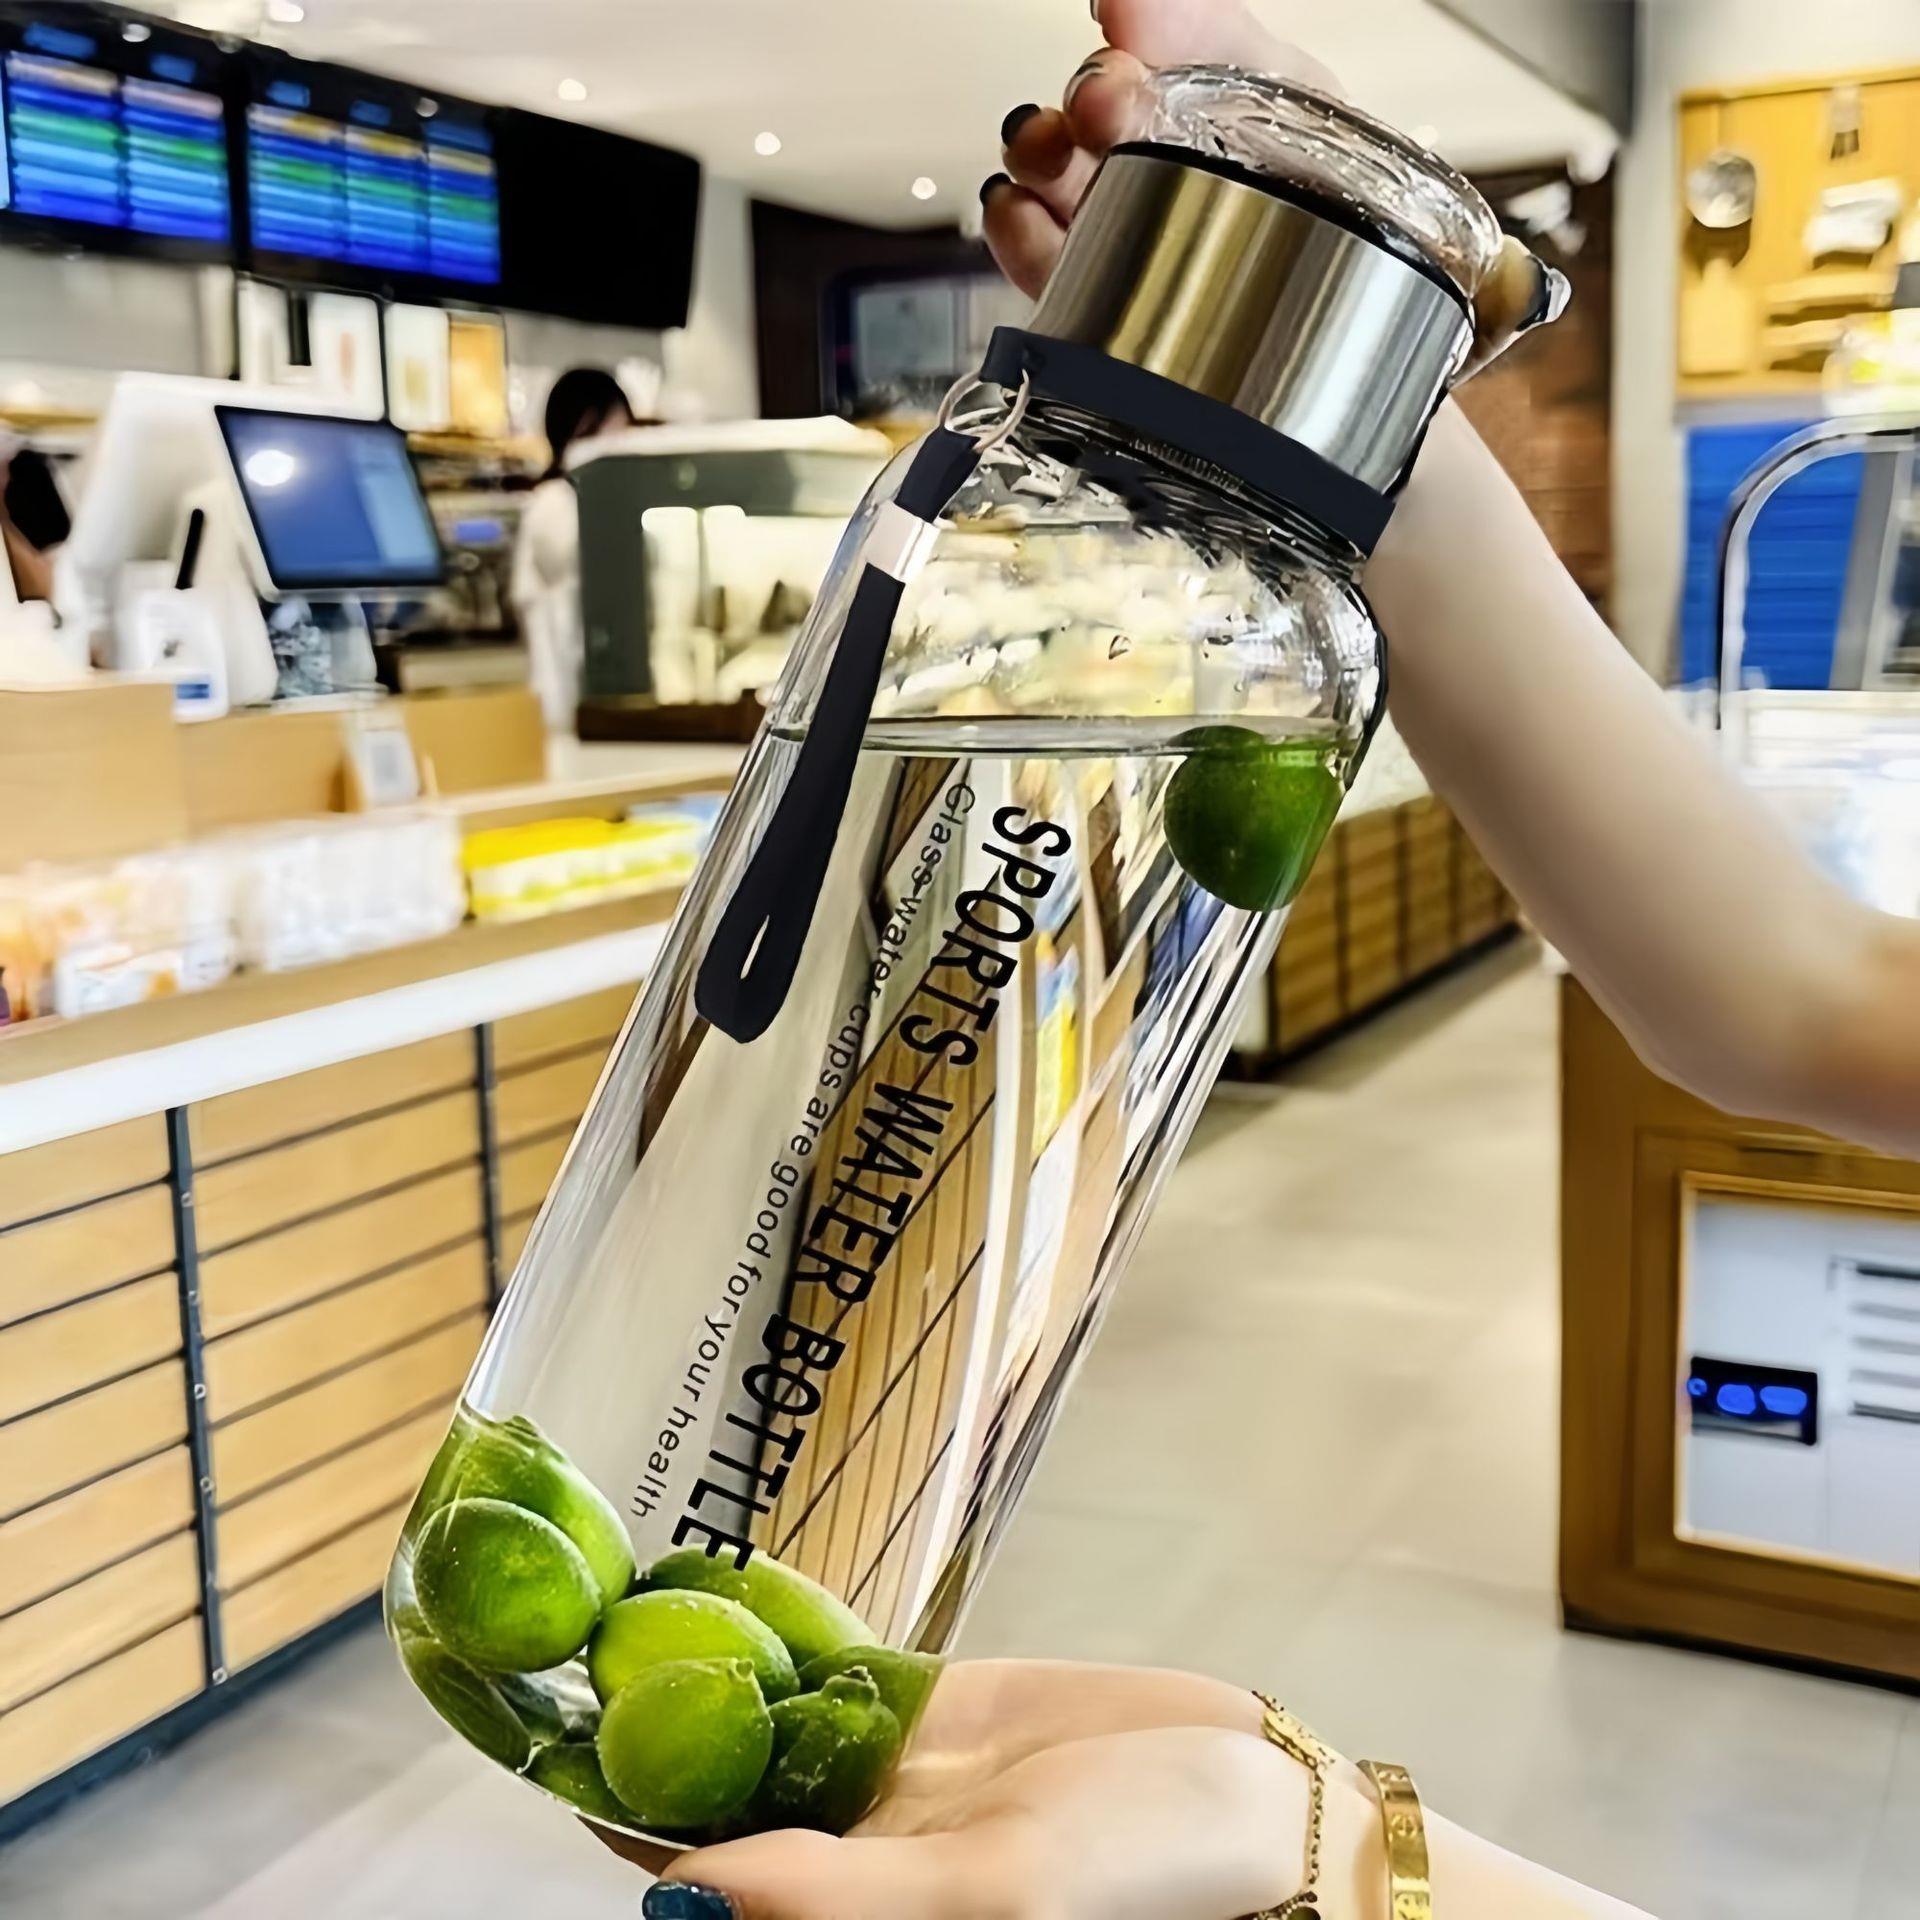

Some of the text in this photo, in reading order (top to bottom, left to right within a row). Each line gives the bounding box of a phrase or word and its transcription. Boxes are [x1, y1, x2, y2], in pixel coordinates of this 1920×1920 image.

[819, 1004, 869, 1090] cups
[790, 1096, 830, 1157] are
[671, 806, 1072, 1571] SPORTS WATER BOTTLE
[746, 1160, 800, 1259] good
[722, 1261, 763, 1315] for
[682, 1314, 732, 1402] your
[630, 1406, 698, 1518] health
